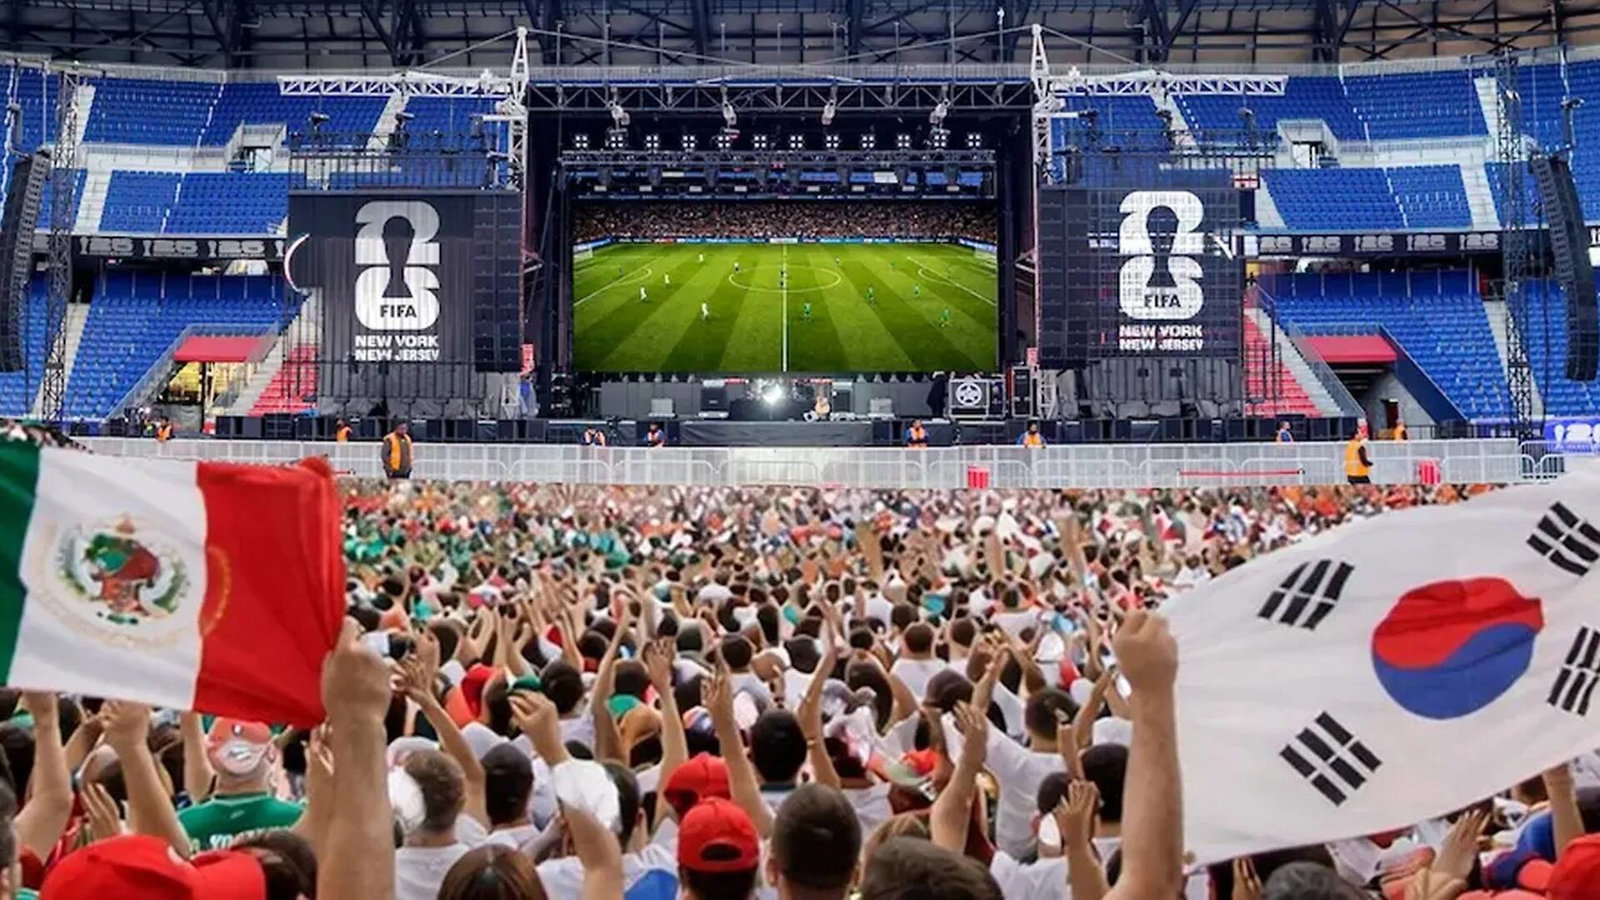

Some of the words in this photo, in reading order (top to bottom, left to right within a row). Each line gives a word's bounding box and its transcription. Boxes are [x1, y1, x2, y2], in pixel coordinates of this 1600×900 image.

[1144, 294, 1181, 308] FIFA
[380, 304, 417, 318] FIFA
[1119, 325, 1156, 337] NEW
[1159, 325, 1202, 337] YORK
[355, 335, 392, 347] NEW
[1119, 339, 1156, 350] NEW
[355, 349, 392, 361] NEW
